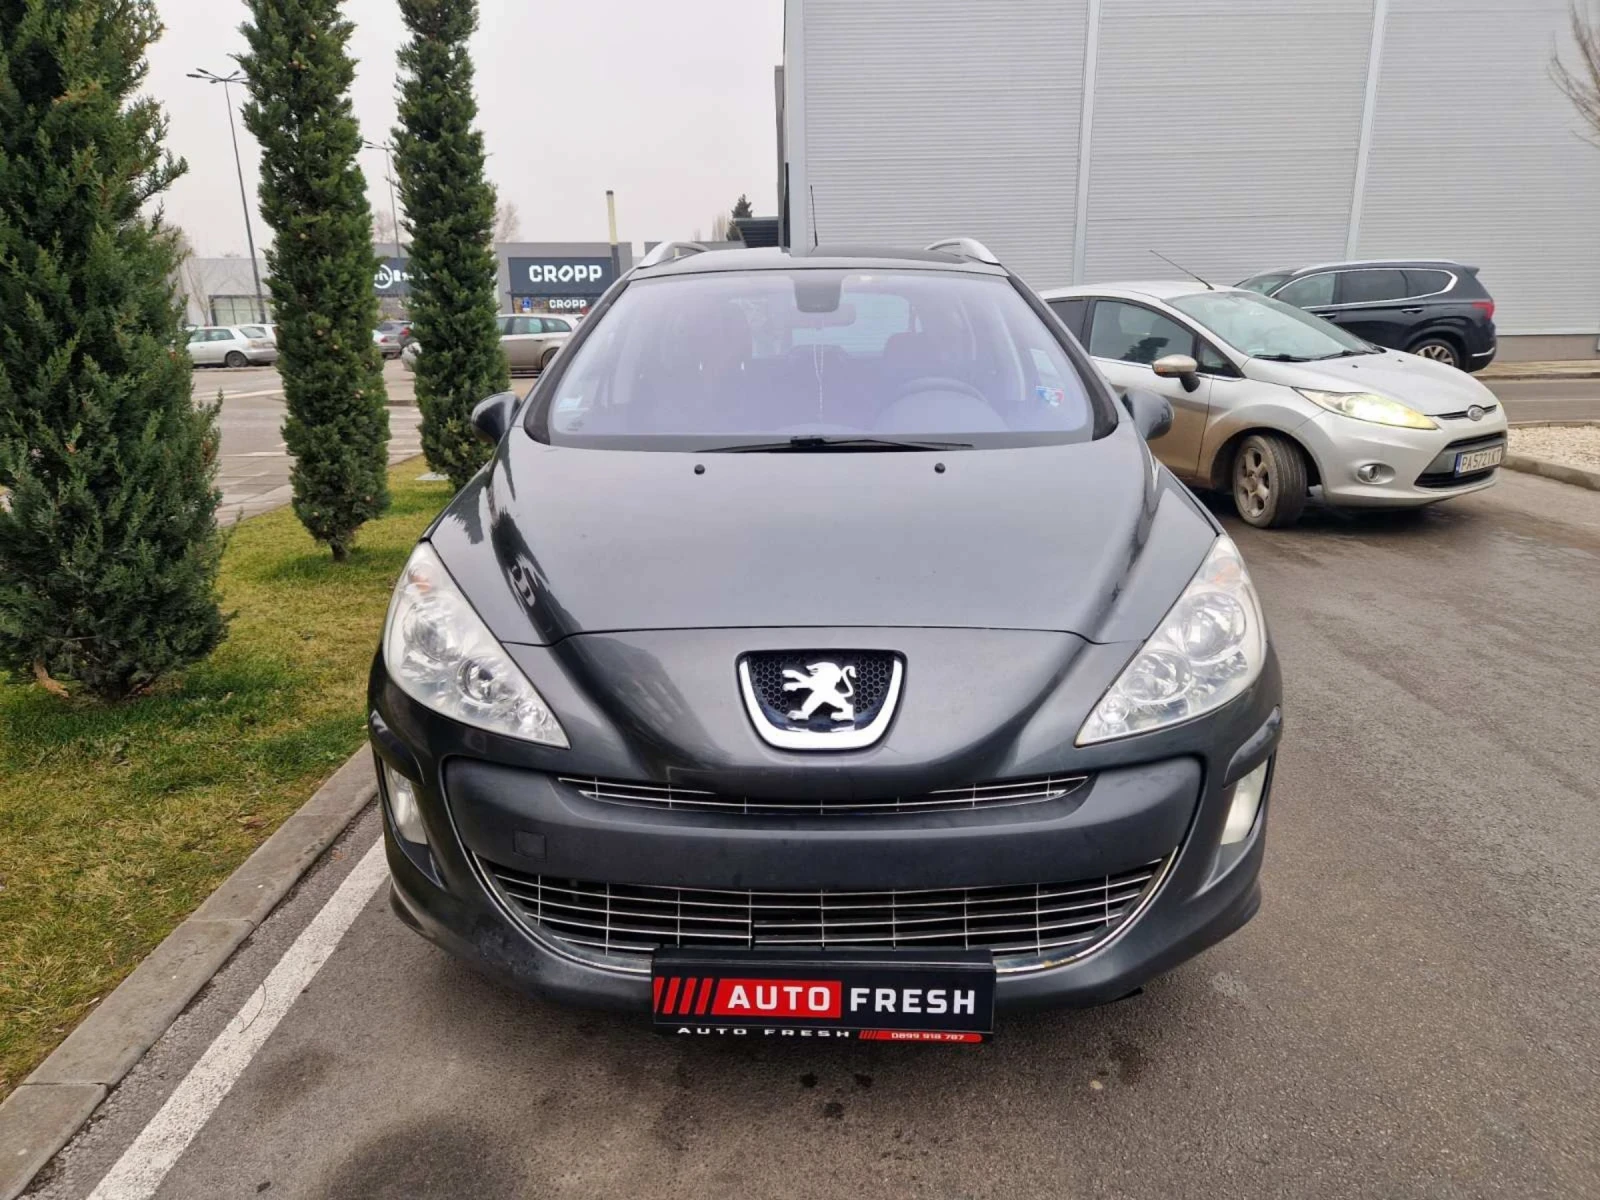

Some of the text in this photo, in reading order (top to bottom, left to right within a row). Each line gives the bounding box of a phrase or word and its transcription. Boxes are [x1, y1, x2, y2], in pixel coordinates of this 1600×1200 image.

[528, 264, 602, 282] CROPP
[549, 299, 587, 309] CROPP
[727, 985, 975, 1014] AUTO FRESH
[677, 1027, 748, 1036] AUTO
[764, 1028, 849, 1038] FRESH
